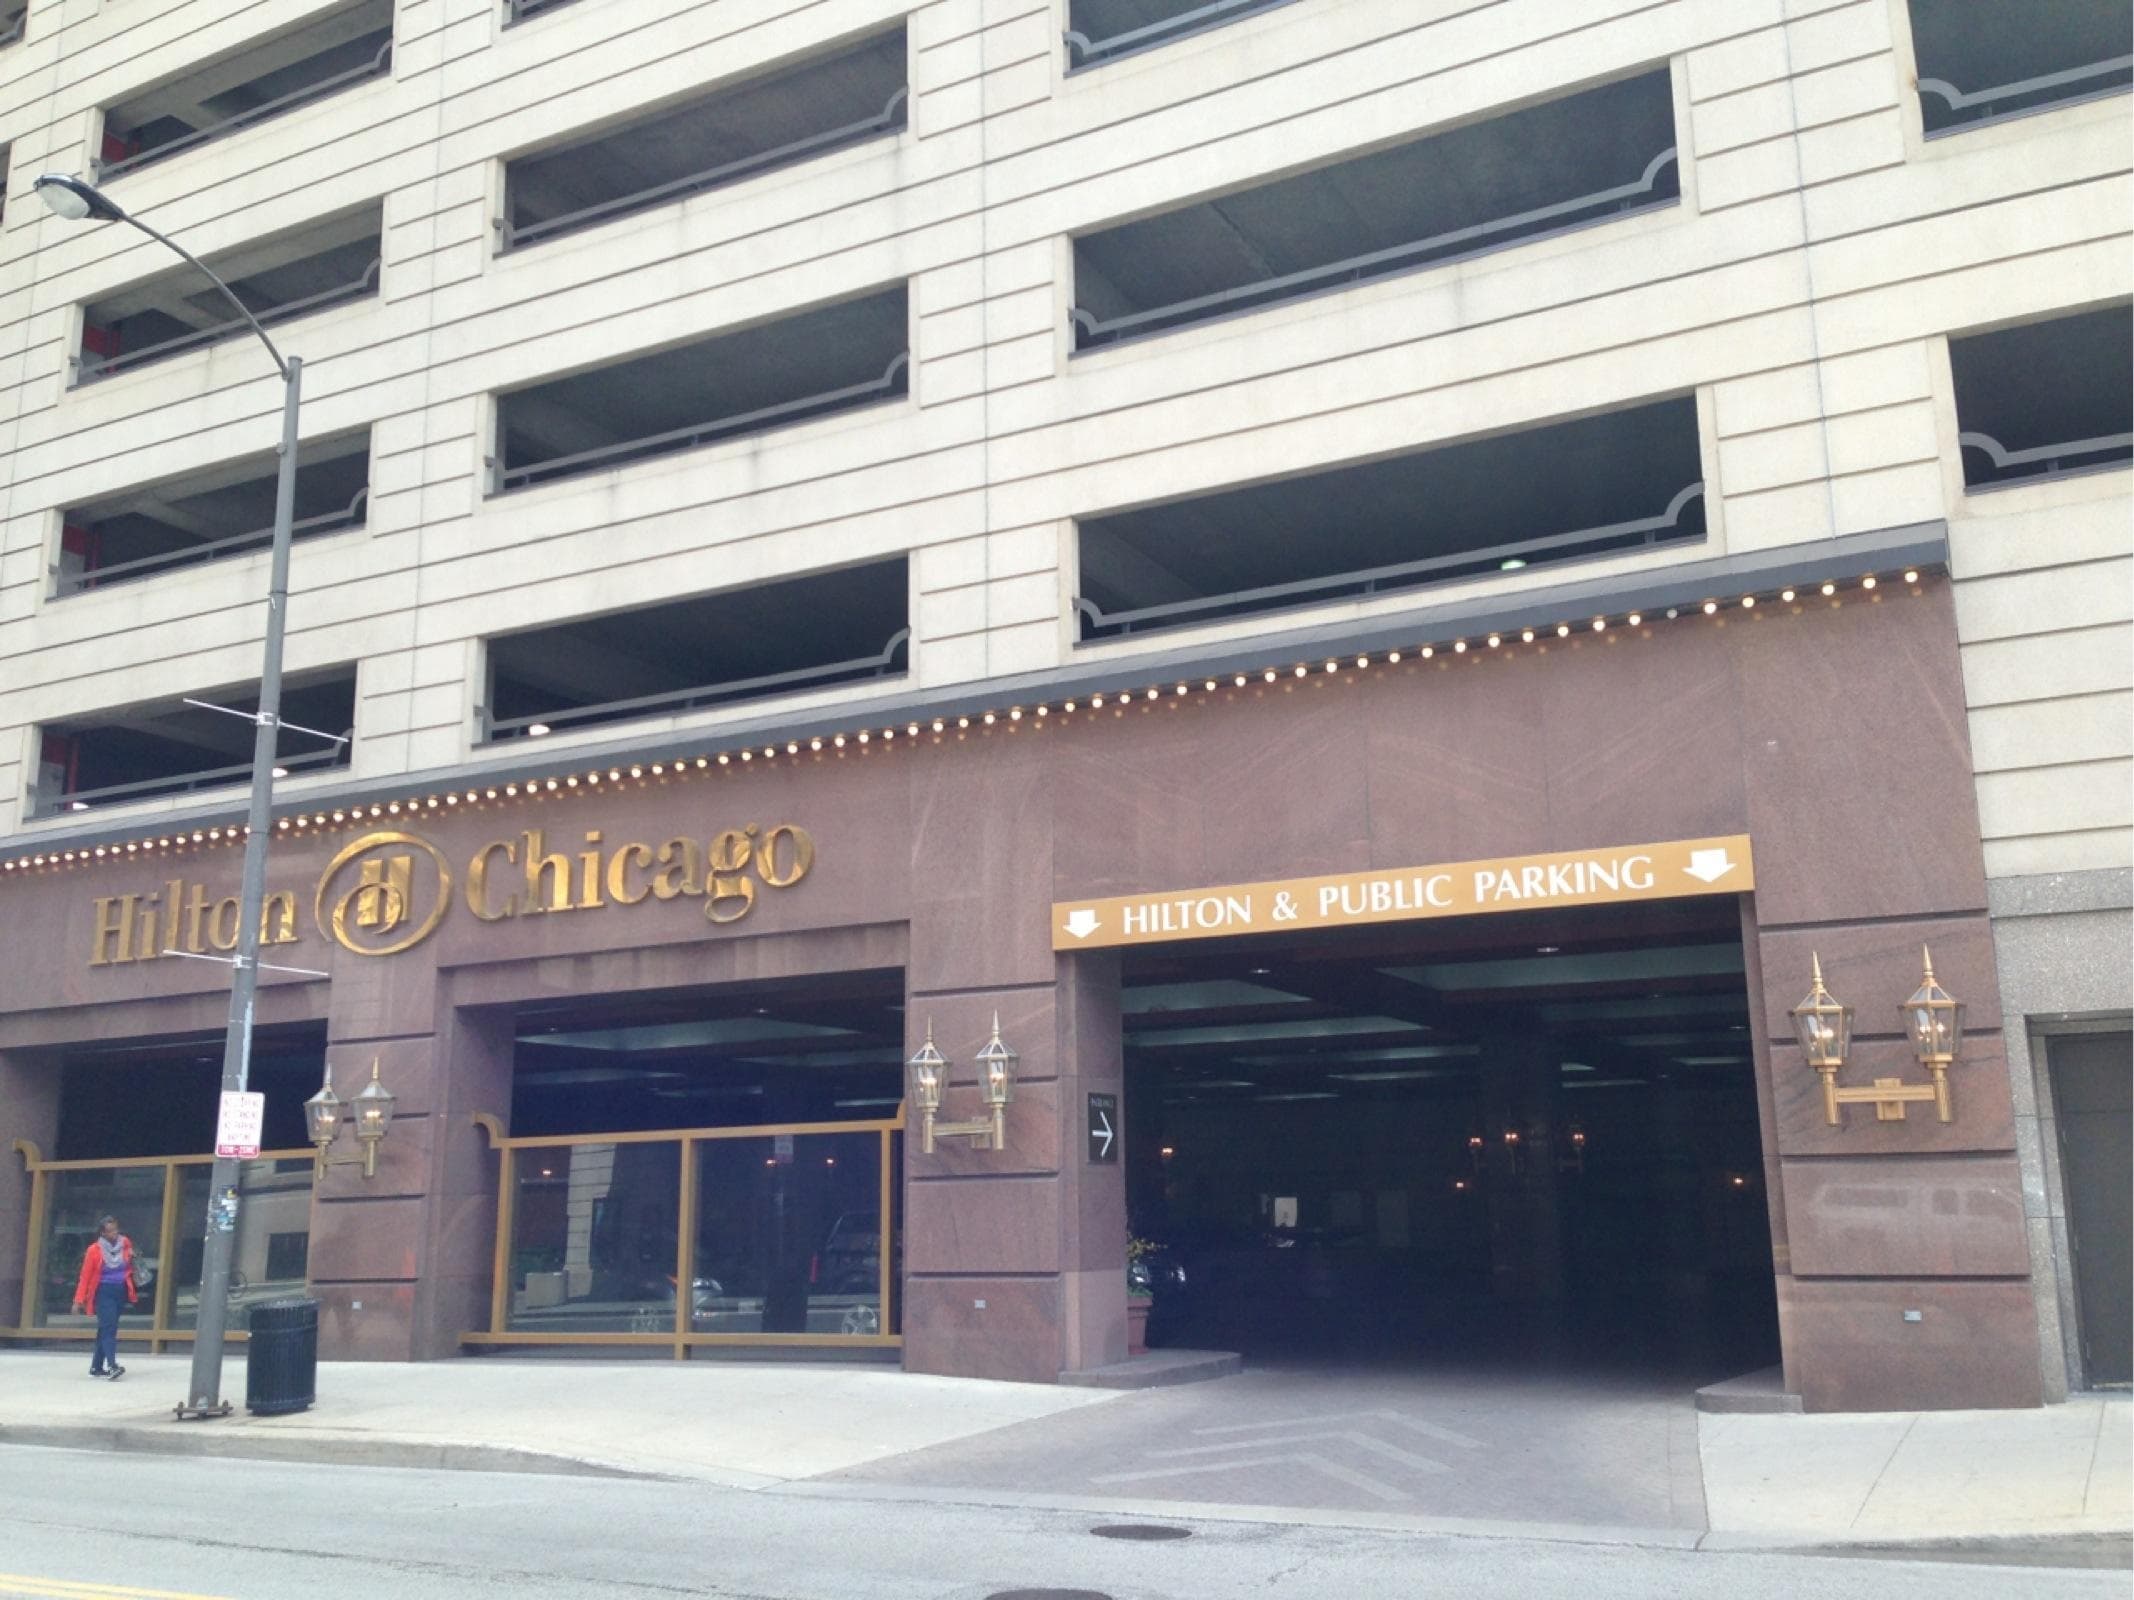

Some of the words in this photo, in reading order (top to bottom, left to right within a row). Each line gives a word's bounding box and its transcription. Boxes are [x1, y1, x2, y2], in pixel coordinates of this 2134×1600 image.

[88, 878, 300, 966] Hilton
[466, 822, 814, 922] Chicago
[1123, 894, 1252, 935] HILTON
[1272, 890, 1298, 921] &
[1319, 874, 1452, 917] PUBLIC
[1474, 855, 1655, 901] PARKING
